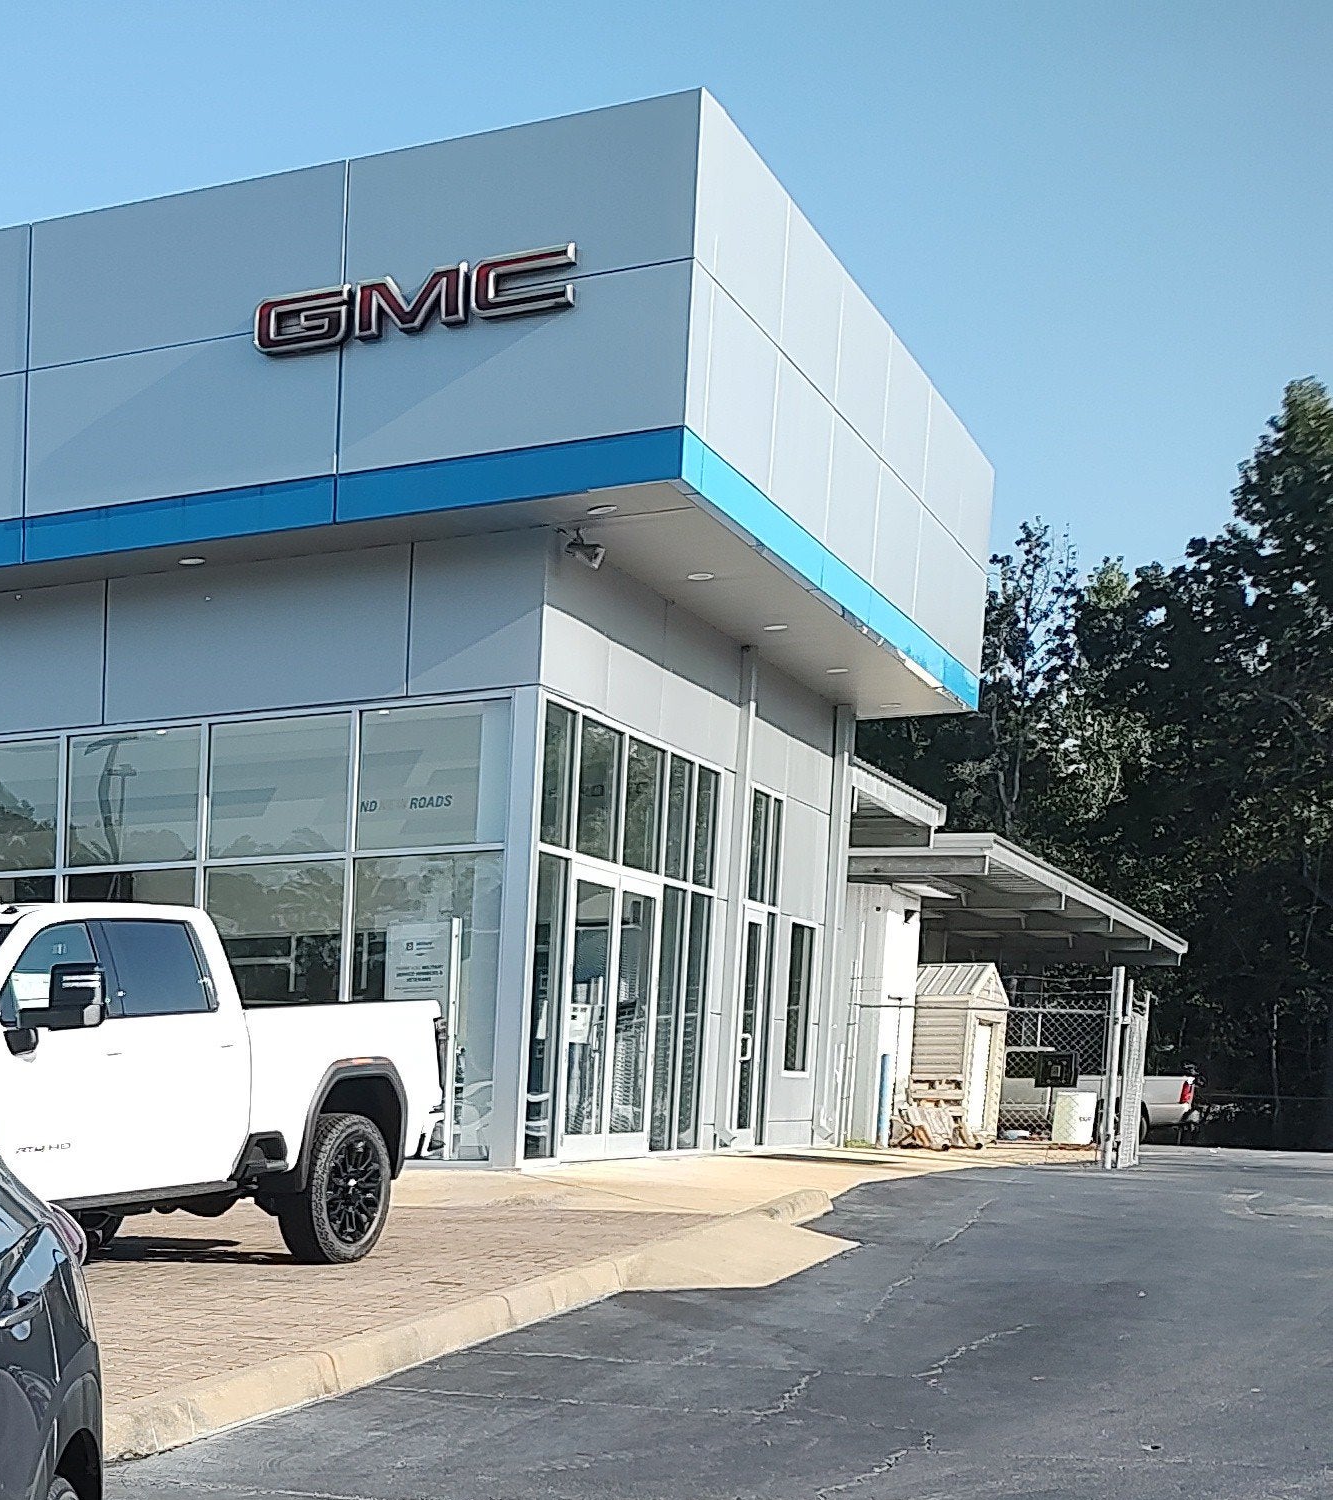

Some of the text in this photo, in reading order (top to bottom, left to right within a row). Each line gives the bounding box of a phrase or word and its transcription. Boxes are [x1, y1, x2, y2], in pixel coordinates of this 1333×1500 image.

[254, 241, 578, 357] GMC
[360, 800, 378, 813] ND
[410, 795, 452, 810] ROADS
